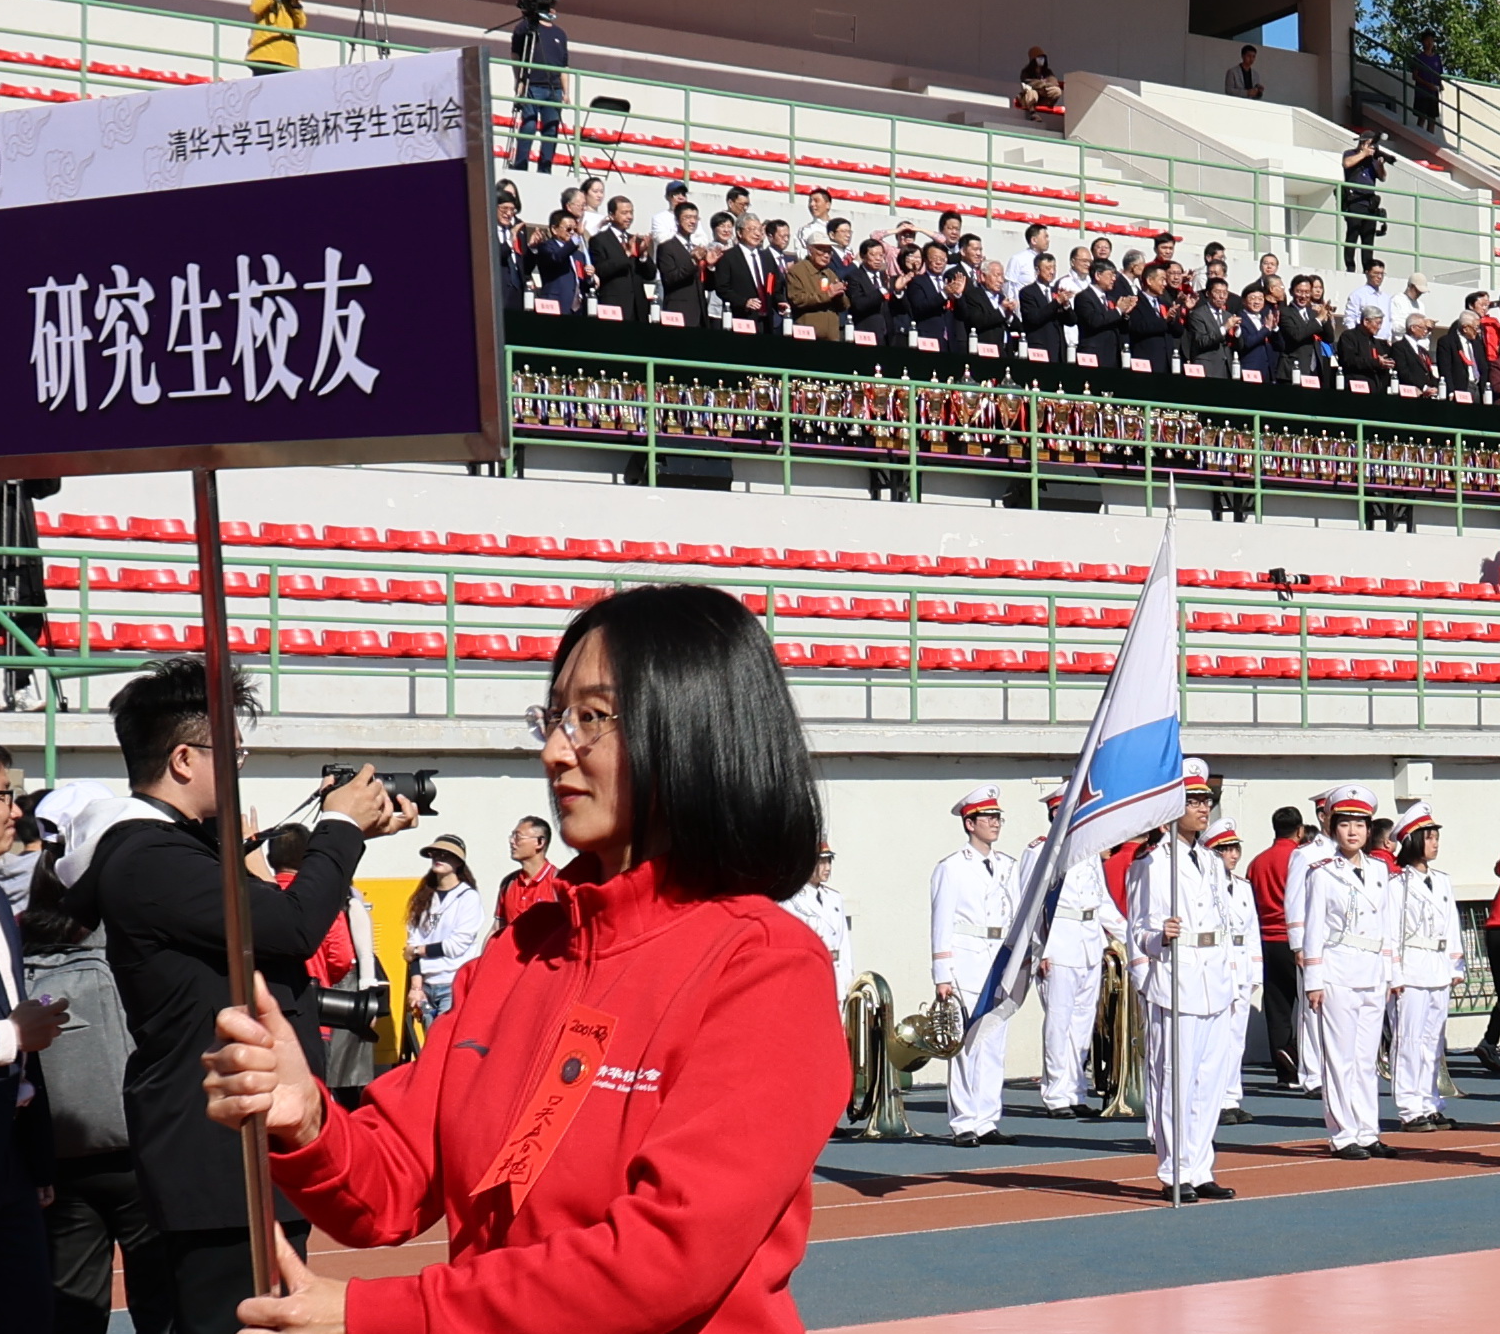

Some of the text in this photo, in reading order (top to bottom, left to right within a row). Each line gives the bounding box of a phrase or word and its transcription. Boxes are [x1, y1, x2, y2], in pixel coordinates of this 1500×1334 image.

[167, 96, 463, 164] 清华大学马约翰杯学生运动会
[26, 246, 381, 414] 研究生校友
